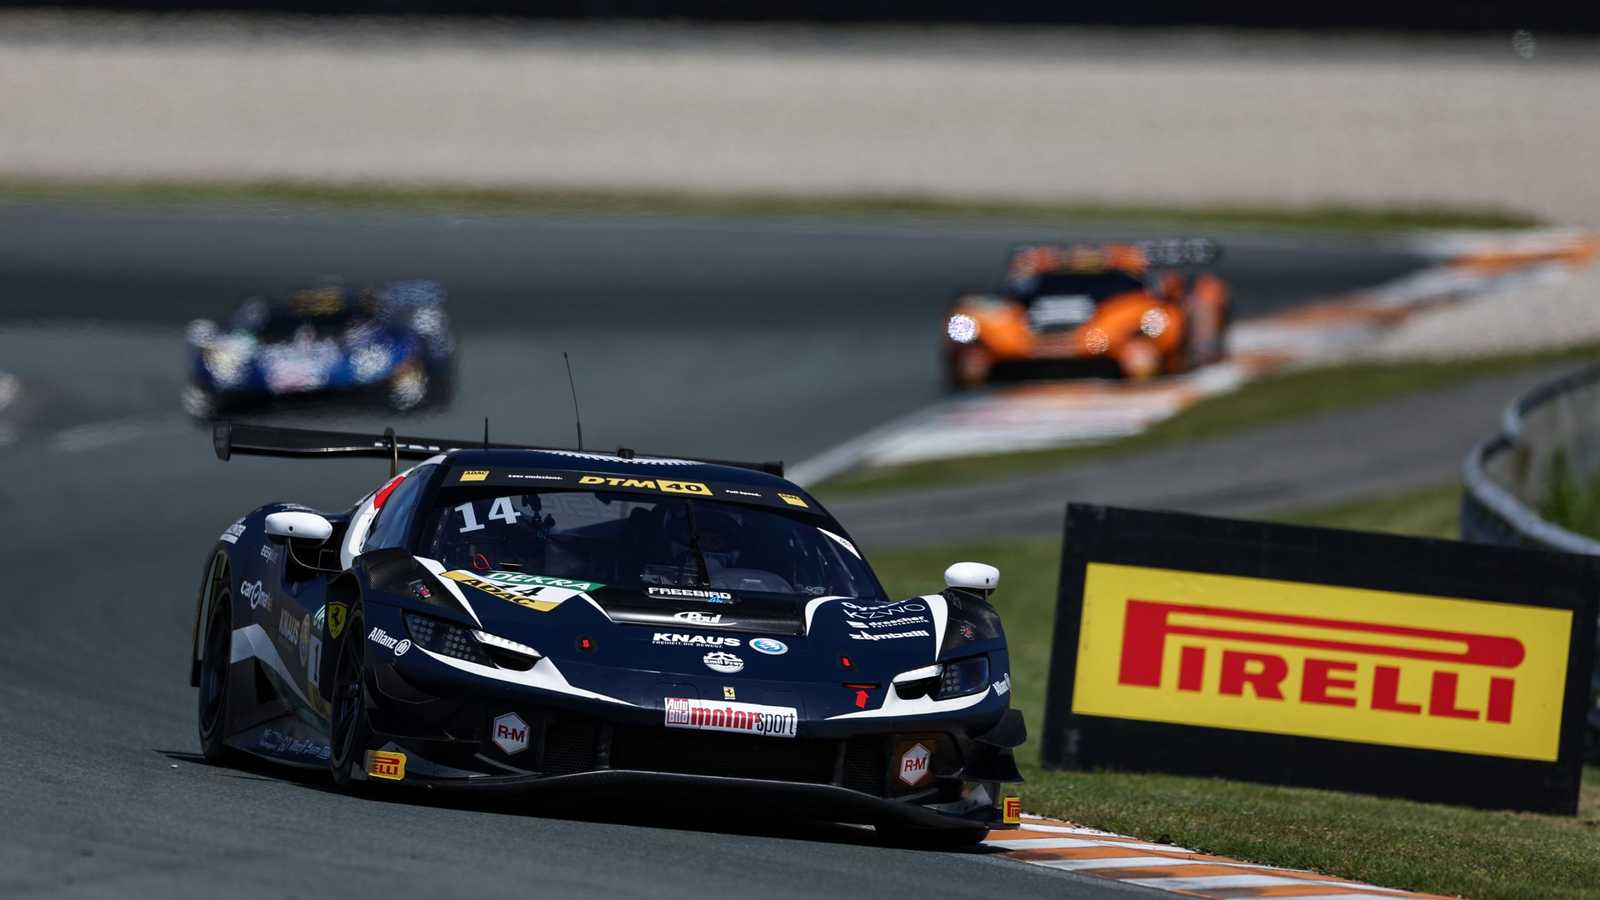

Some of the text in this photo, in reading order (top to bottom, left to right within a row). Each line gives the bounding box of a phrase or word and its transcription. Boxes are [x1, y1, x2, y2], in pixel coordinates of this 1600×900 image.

[579, 476, 656, 489] DTM
[454, 496, 520, 533] 14
[489, 572, 592, 590] DEKRA
[460, 579, 536, 605] ADAC
[843, 603, 926, 618] KZWO
[368, 626, 398, 649] Allianz
[653, 633, 741, 646] KNAUS
[1118, 599, 1526, 724] PIRELLI
[498, 725, 525, 743] R-M
[904, 757, 928, 772] R-M
